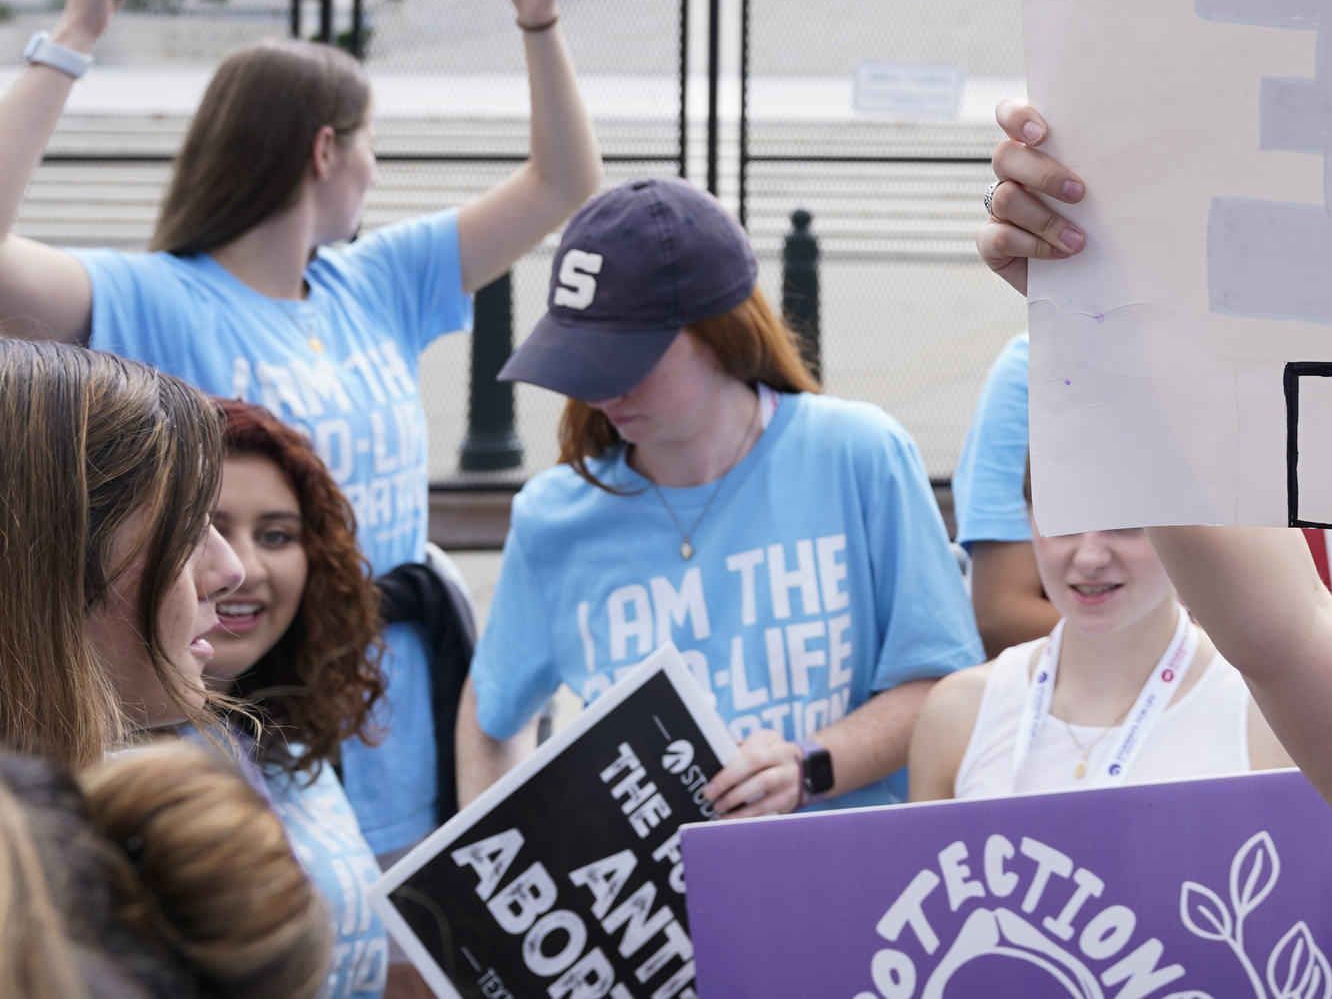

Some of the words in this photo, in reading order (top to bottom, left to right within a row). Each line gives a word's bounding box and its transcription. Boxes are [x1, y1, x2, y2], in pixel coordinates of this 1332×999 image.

[553, 248, 603, 311] S
[576, 601, 596, 673] I
[607, 566, 712, 663] AM
[726, 533, 849, 626] THE
[600, 741, 674, 839] THE
[852, 834, 1186, 999] OTECTION
